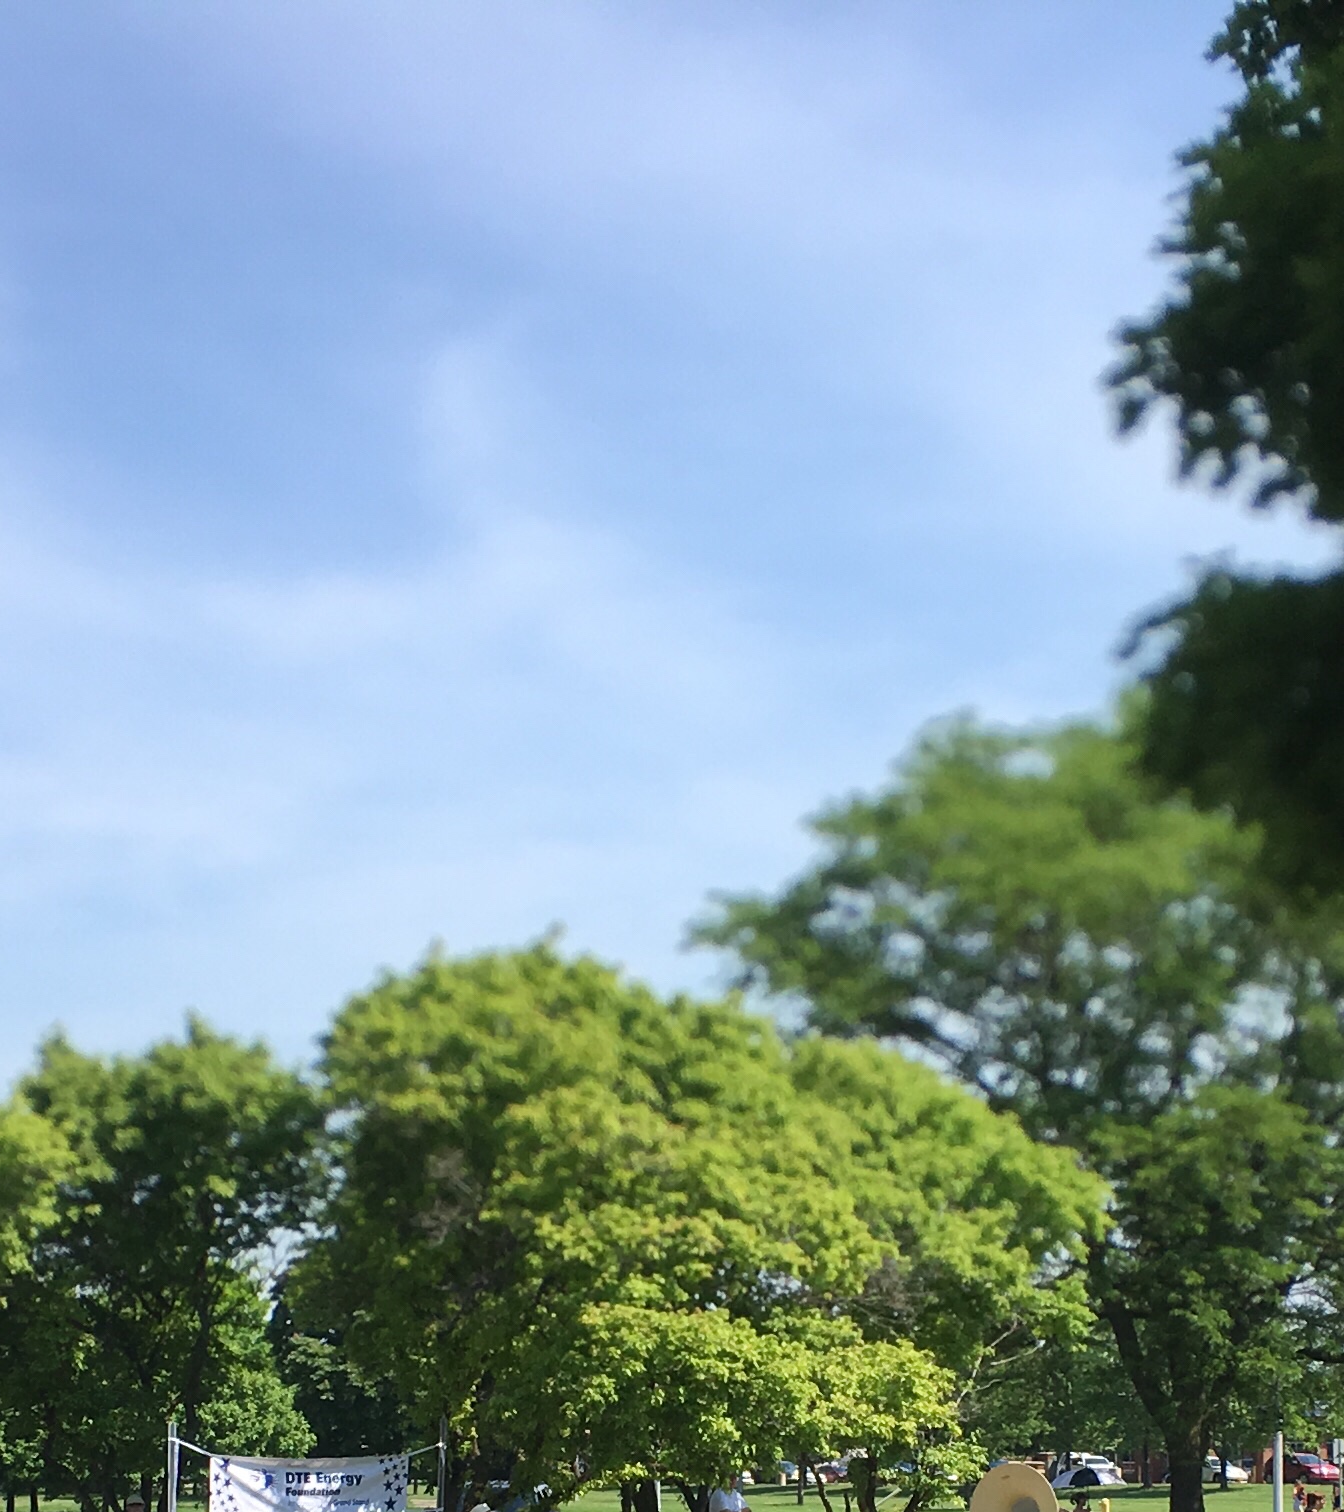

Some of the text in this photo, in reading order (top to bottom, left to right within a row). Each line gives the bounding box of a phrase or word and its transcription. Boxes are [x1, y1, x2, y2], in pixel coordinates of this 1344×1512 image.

[285, 1472, 362, 1486] DTE Energy
[285, 1487, 341, 1496] Foundation
